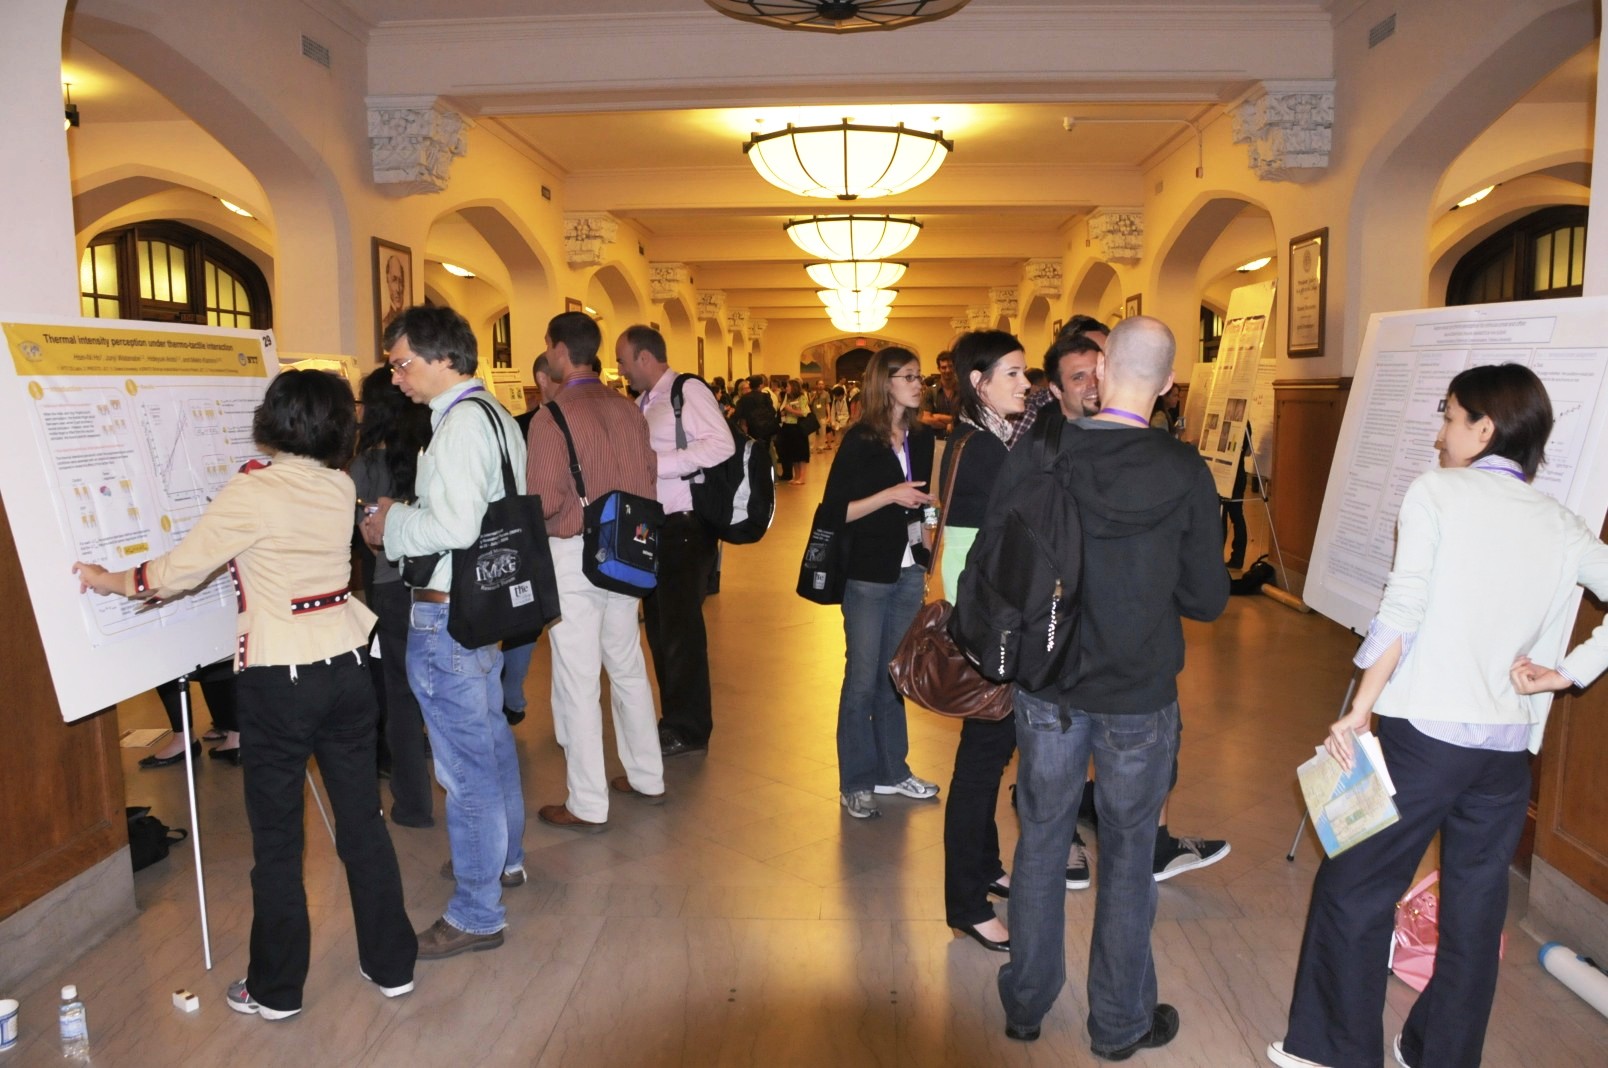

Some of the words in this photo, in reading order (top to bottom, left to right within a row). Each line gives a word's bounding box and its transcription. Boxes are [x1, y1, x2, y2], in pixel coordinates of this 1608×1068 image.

[42, 333, 76, 345] Thermal
[77, 335, 110, 348] intensity
[111, 338, 147, 349] perception
[148, 339, 166, 348] under
[207, 343, 234, 351] interaction
[262, 335, 272, 348] 29
